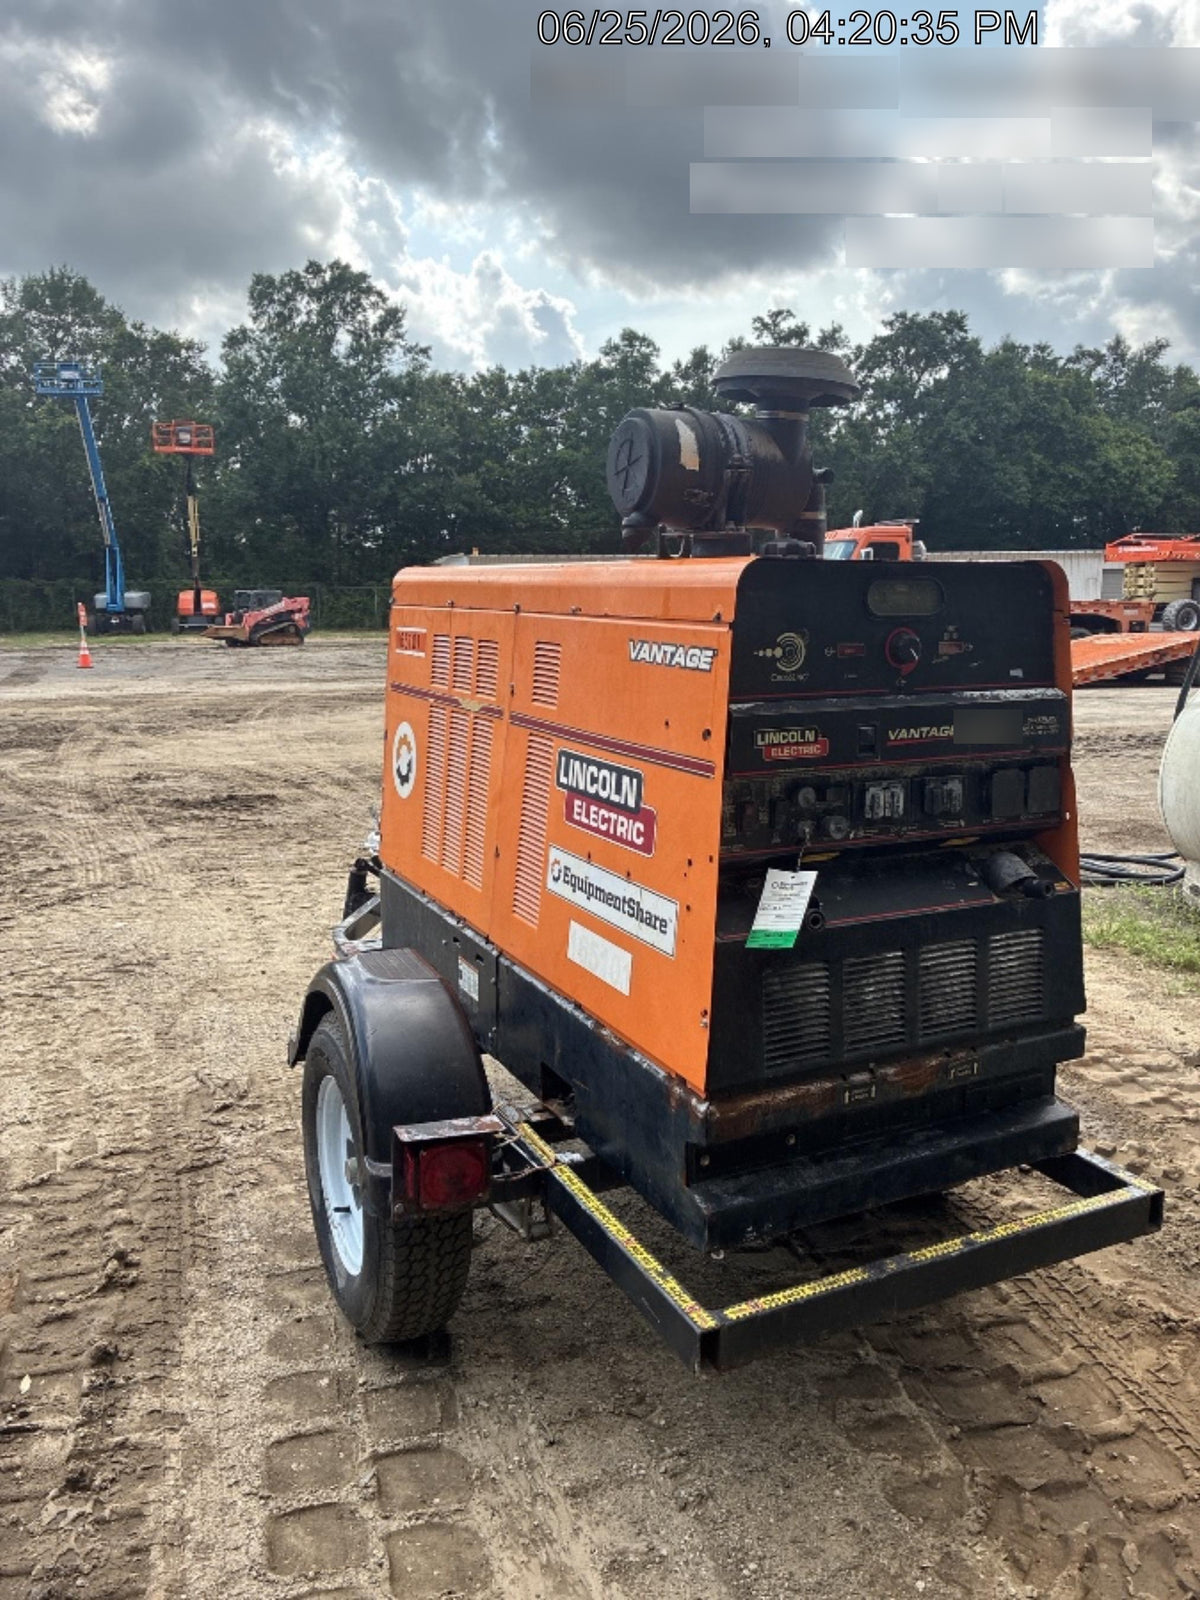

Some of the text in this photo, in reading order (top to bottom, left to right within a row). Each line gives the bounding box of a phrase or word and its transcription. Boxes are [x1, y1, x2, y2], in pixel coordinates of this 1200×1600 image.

[628, 641, 715, 671] VANTAGE
[757, 729, 816, 746] LINCOLN
[771, 744, 822, 757] ELECTRIC
[559, 756, 638, 809] LINCOLN
[572, 798, 645, 846] ELECTRIC
[562, 864, 669, 935] EquipmentShare
